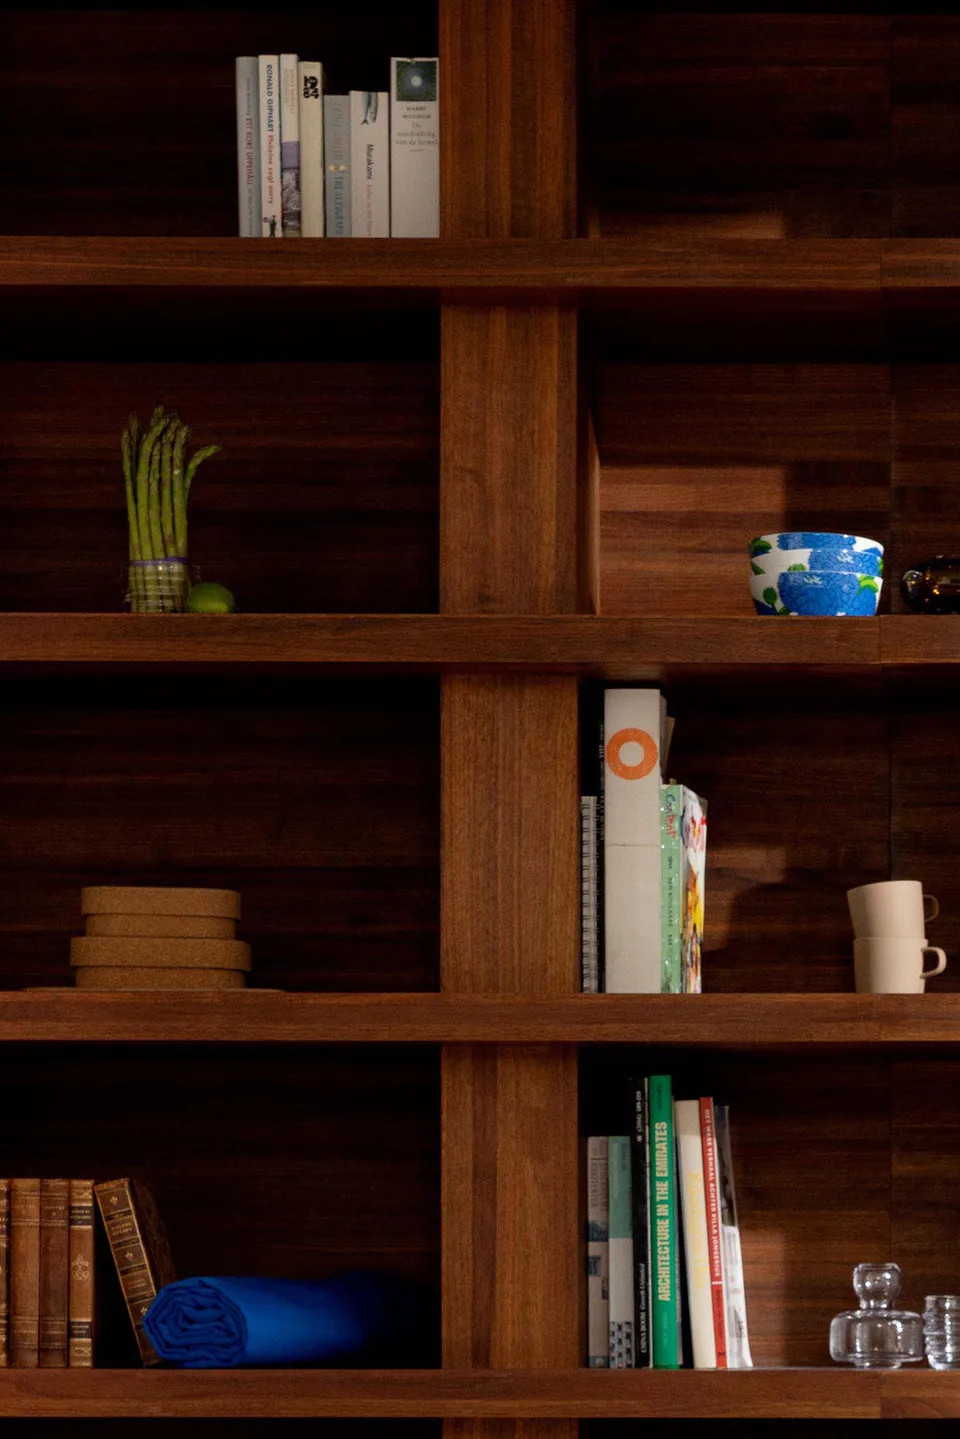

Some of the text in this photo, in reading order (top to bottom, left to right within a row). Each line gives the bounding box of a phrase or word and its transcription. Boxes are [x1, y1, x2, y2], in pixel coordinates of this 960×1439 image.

[266, 64, 274, 97] RONALD
[267, 134, 275, 165] Phileine
[366, 143, 374, 180] Murakami
[664, 793, 677, 839] Content
[655, 1121, 668, 1177] EMIRATES
[707, 1147, 715, 1182] VERHAAL
[656, 1181, 669, 1202] THE
[657, 1203, 669, 1213] IN
[709, 1182, 717, 1212] ACHTER
[711, 1213, 719, 1234] VILLA
[657, 1214, 671, 1301] ARCHITECTURE
[712, 1236, 721, 1277] JONGERIUS
